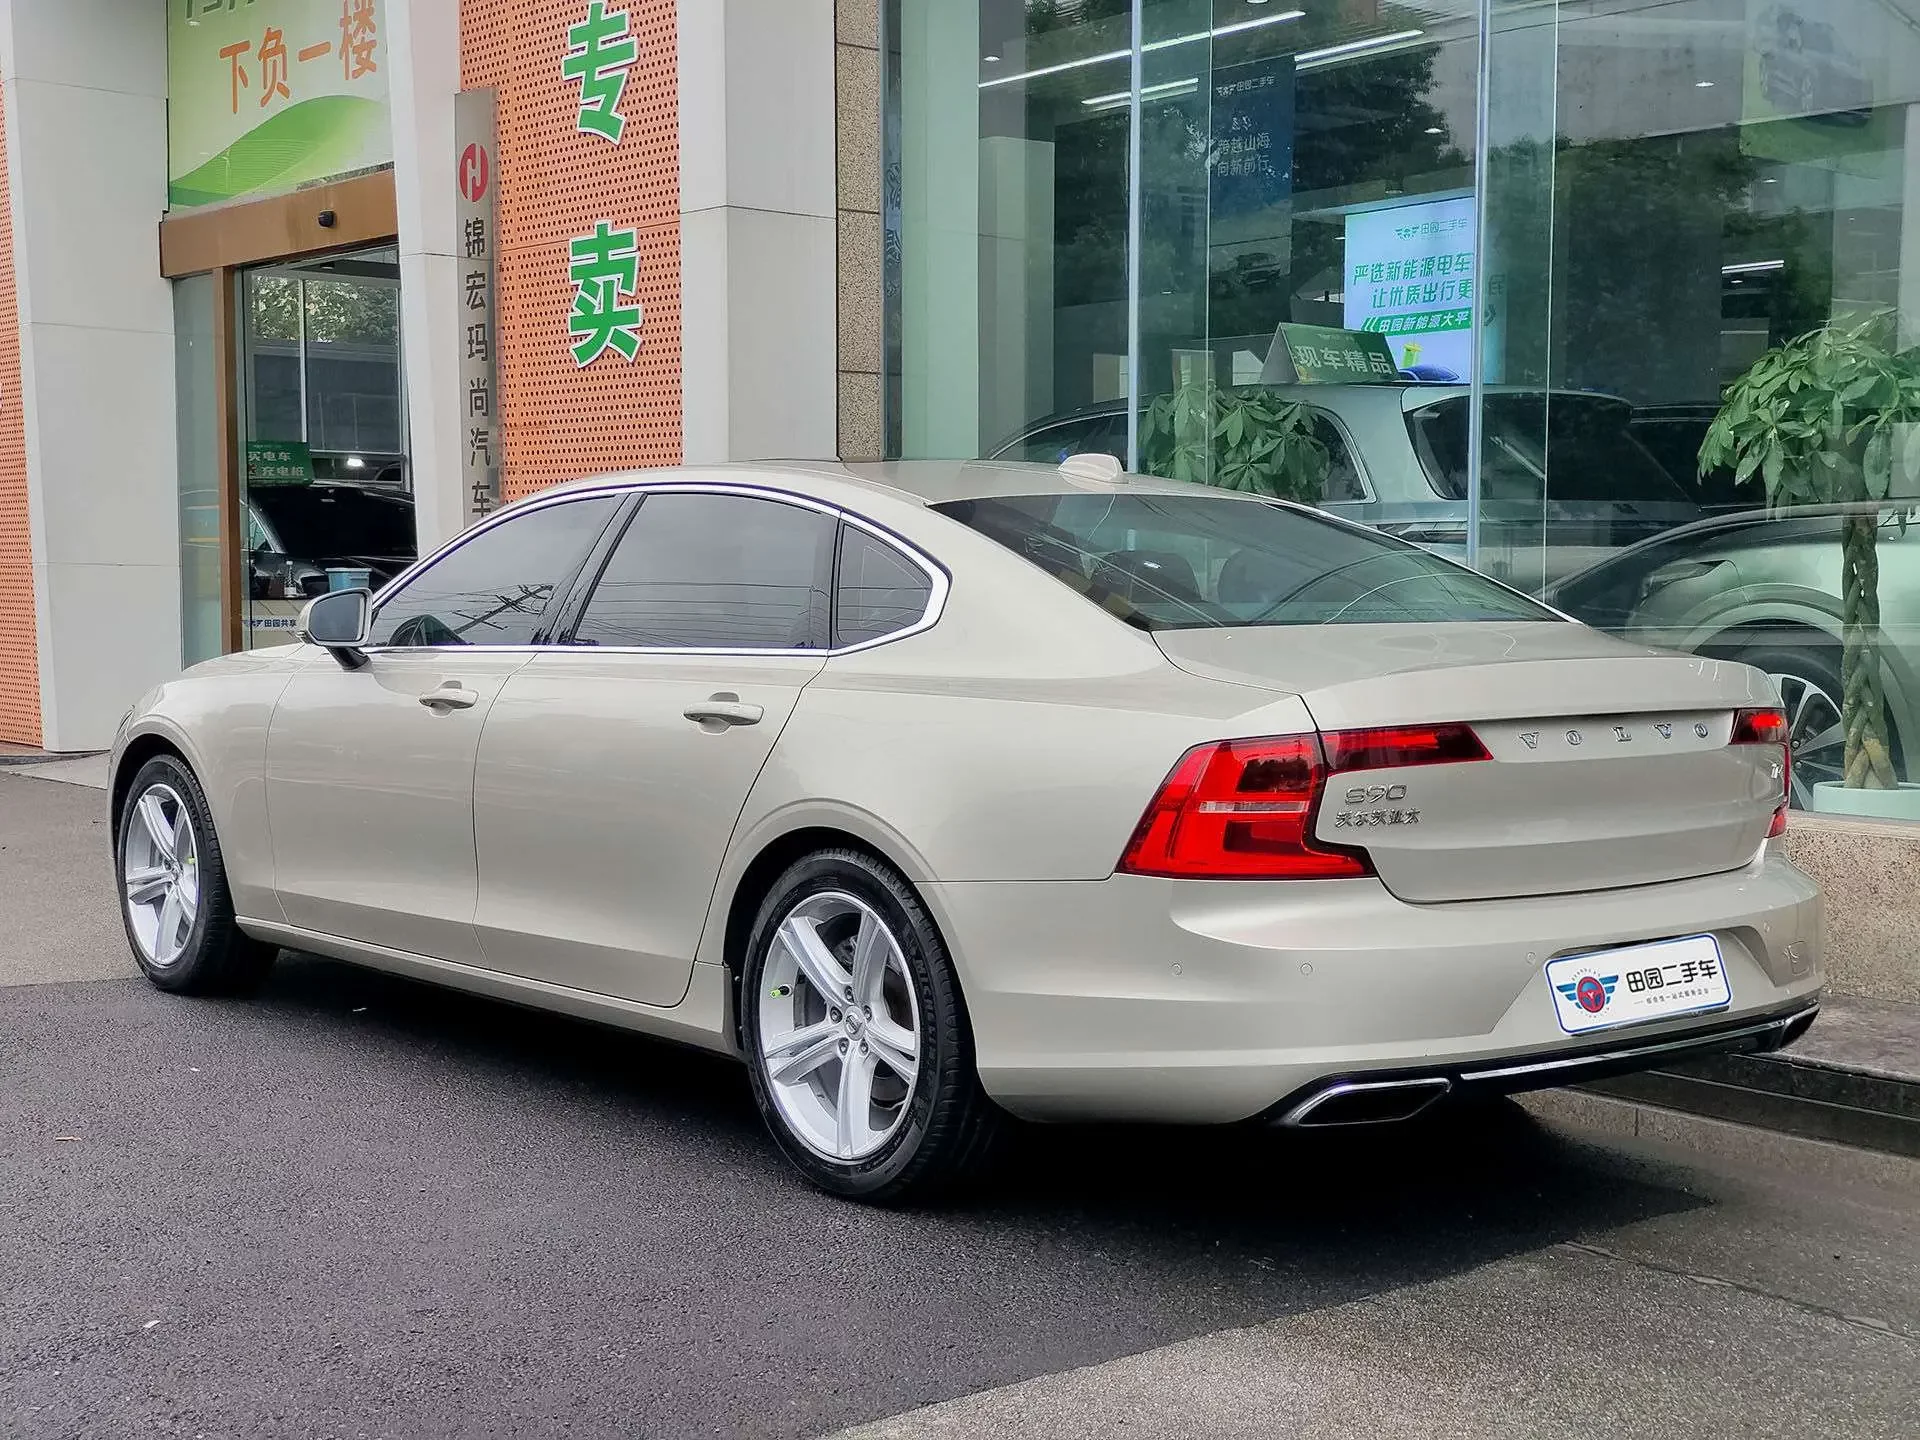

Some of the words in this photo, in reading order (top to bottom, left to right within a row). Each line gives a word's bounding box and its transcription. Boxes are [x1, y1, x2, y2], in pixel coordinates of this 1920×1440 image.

[219, 0, 377, 114] 下负一楼
[562, 0, 642, 368] 专卖
[1421, 218, 1468, 235] 田园二手车
[1353, 252, 1474, 286] 严选新能源电车
[1379, 310, 1471, 332] 田园新能源大平
[464, 217, 492, 518] 锦宏玛尚汽车
[1293, 345, 1393, 375] 现车精品
[1519, 722, 1708, 749] VOLVO
[1345, 784, 1407, 804] S90
[1626, 959, 1718, 993] 田园二手车
